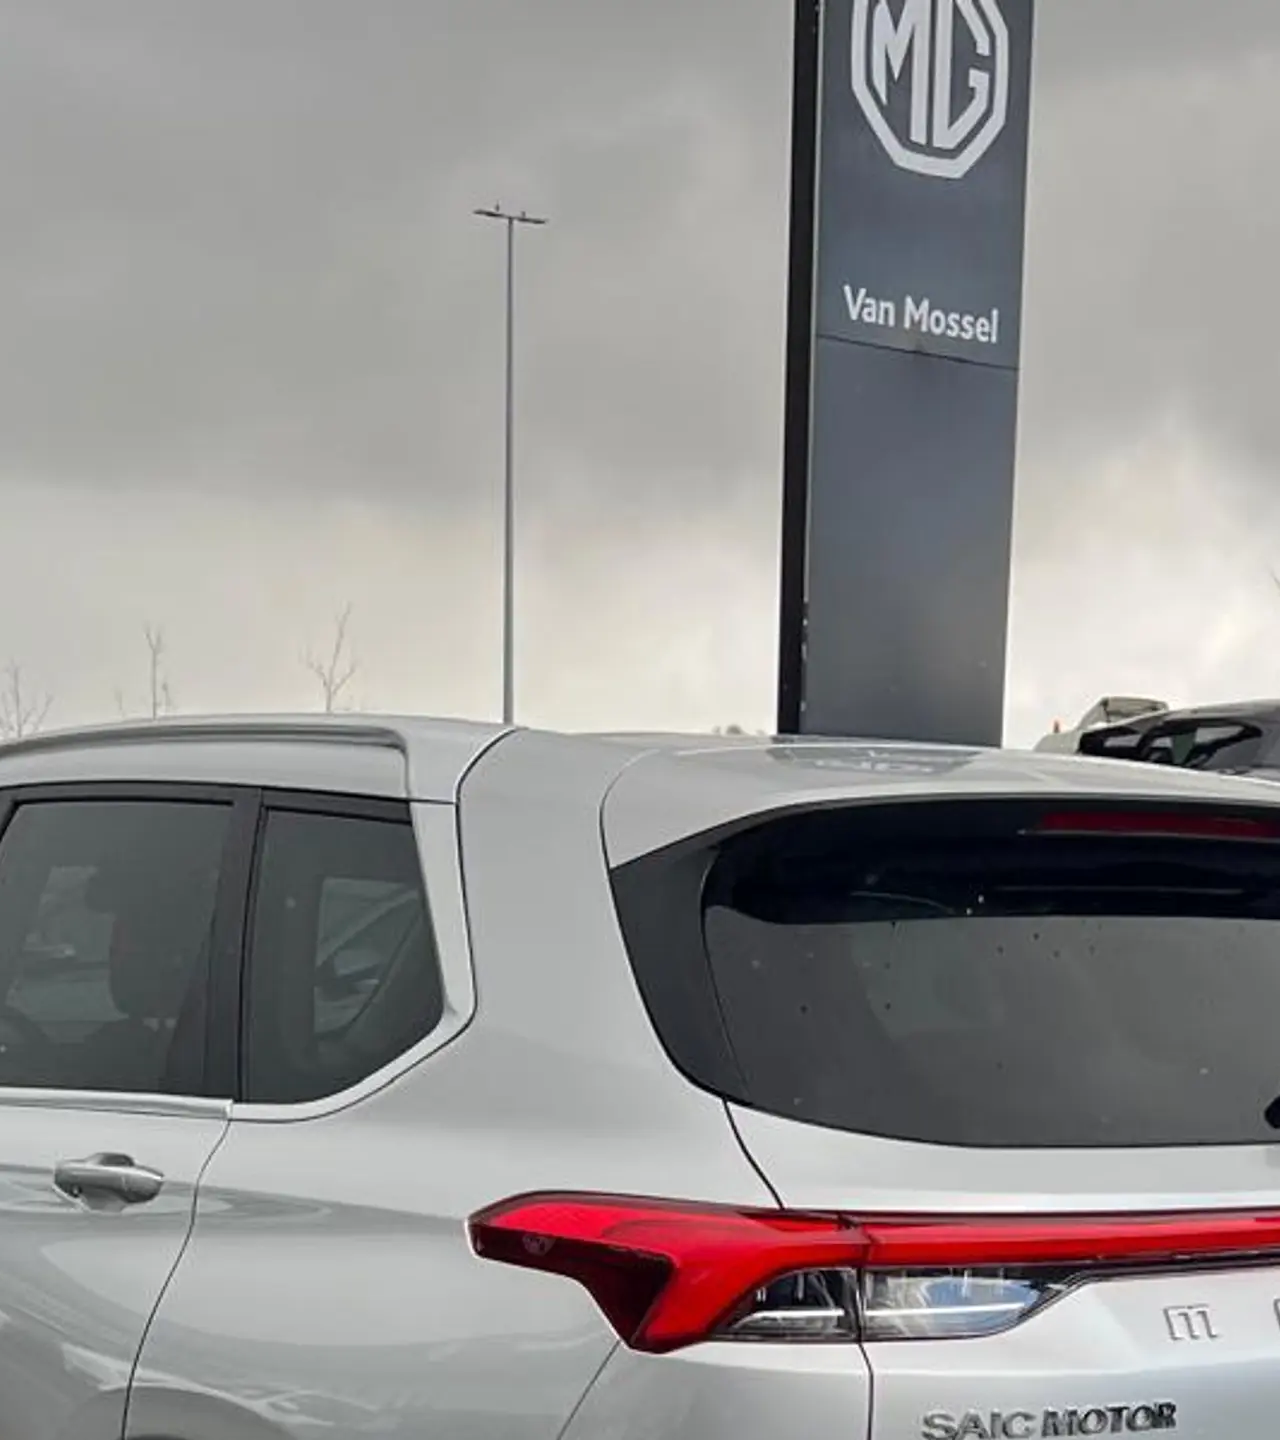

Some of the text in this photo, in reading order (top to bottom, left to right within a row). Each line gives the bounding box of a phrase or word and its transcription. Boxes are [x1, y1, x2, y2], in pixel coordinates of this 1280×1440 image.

[870, 0, 992, 152] MG
[842, 284, 1000, 344] Van Mossel
[1040, 1401, 1178, 1438] MOTOR
